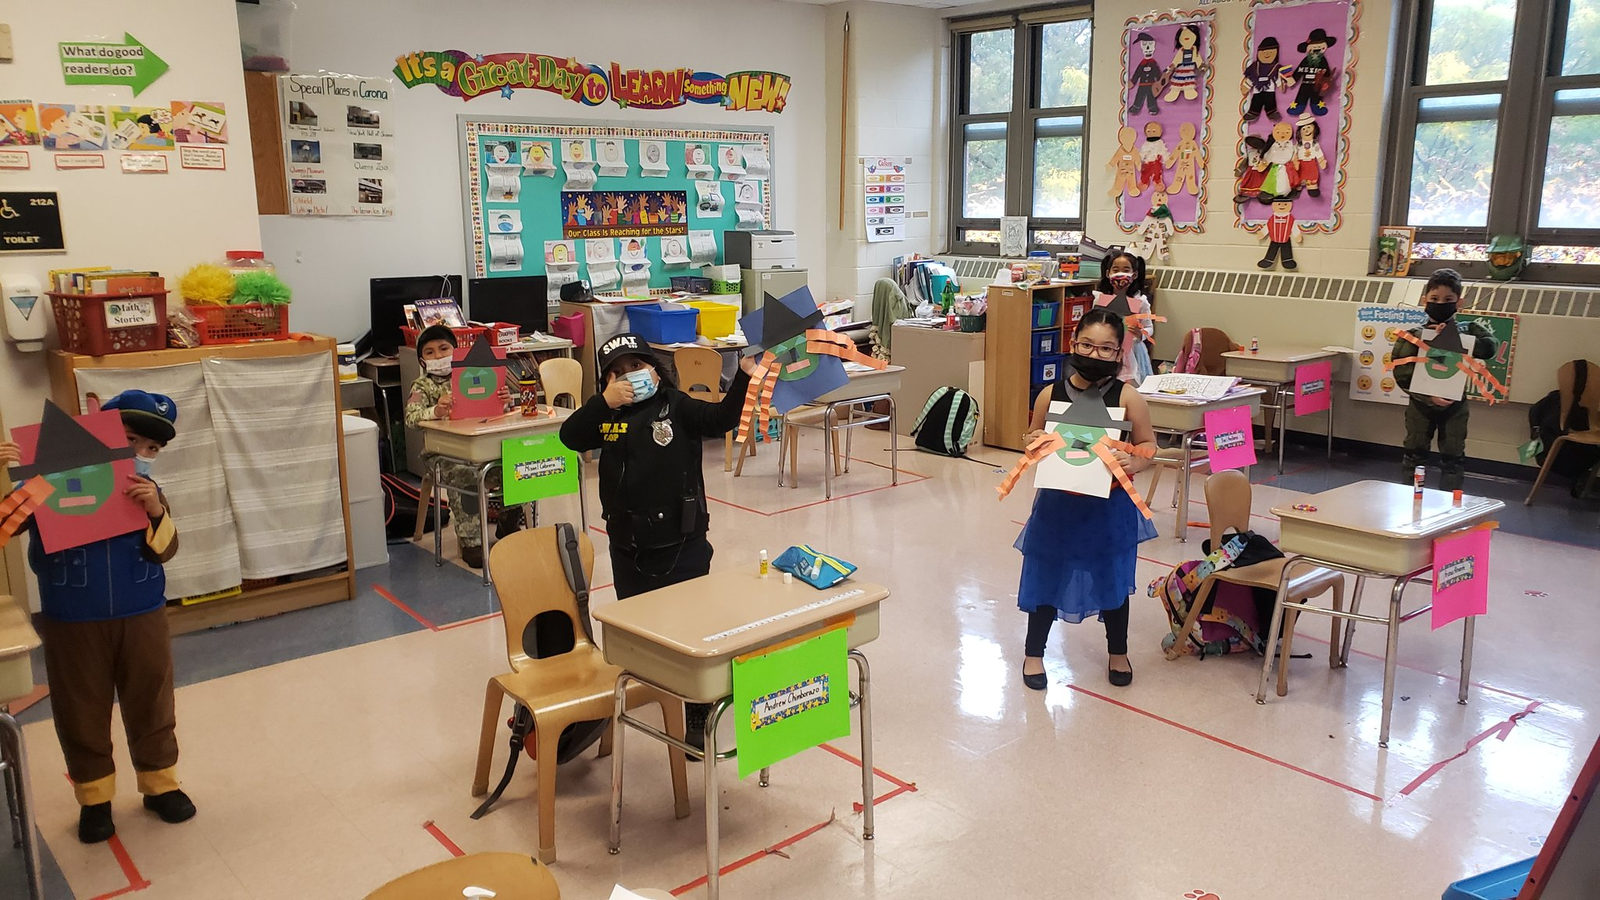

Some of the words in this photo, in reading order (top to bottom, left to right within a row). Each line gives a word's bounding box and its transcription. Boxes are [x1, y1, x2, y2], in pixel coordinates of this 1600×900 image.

[63, 46, 97, 56] What
[99, 47, 114, 57] do
[115, 47, 144, 58] good
[65, 64, 110, 74] readers
[112, 66, 133, 75] do?
[290, 74, 325, 99] Special
[327, 77, 350, 96] Places
[352, 88, 359, 97] in
[395, 50, 437, 83] It's
[440, 60, 456, 83] a
[457, 54, 535, 97] Great
[537, 56, 585, 99] Day
[586, 77, 607, 99] to
[610, 61, 686, 106] LEARN
[683, 81, 727, 96] Something
[726, 74, 791, 112] NEW!
[30, 198, 54, 206] 212A
[567, 229, 581, 237] Our
[582, 229, 600, 237] Class
[610, 228, 640, 237] Reaching
[641, 227, 651, 235] for
[653, 227, 664, 235] the
[665, 226, 684, 234] Stars!
[3, 236, 40, 244] TOILET
[112, 303, 140, 312] Math
[1374, 310, 1405, 321] Feeling
[764, 699, 787, 713] Andrew
